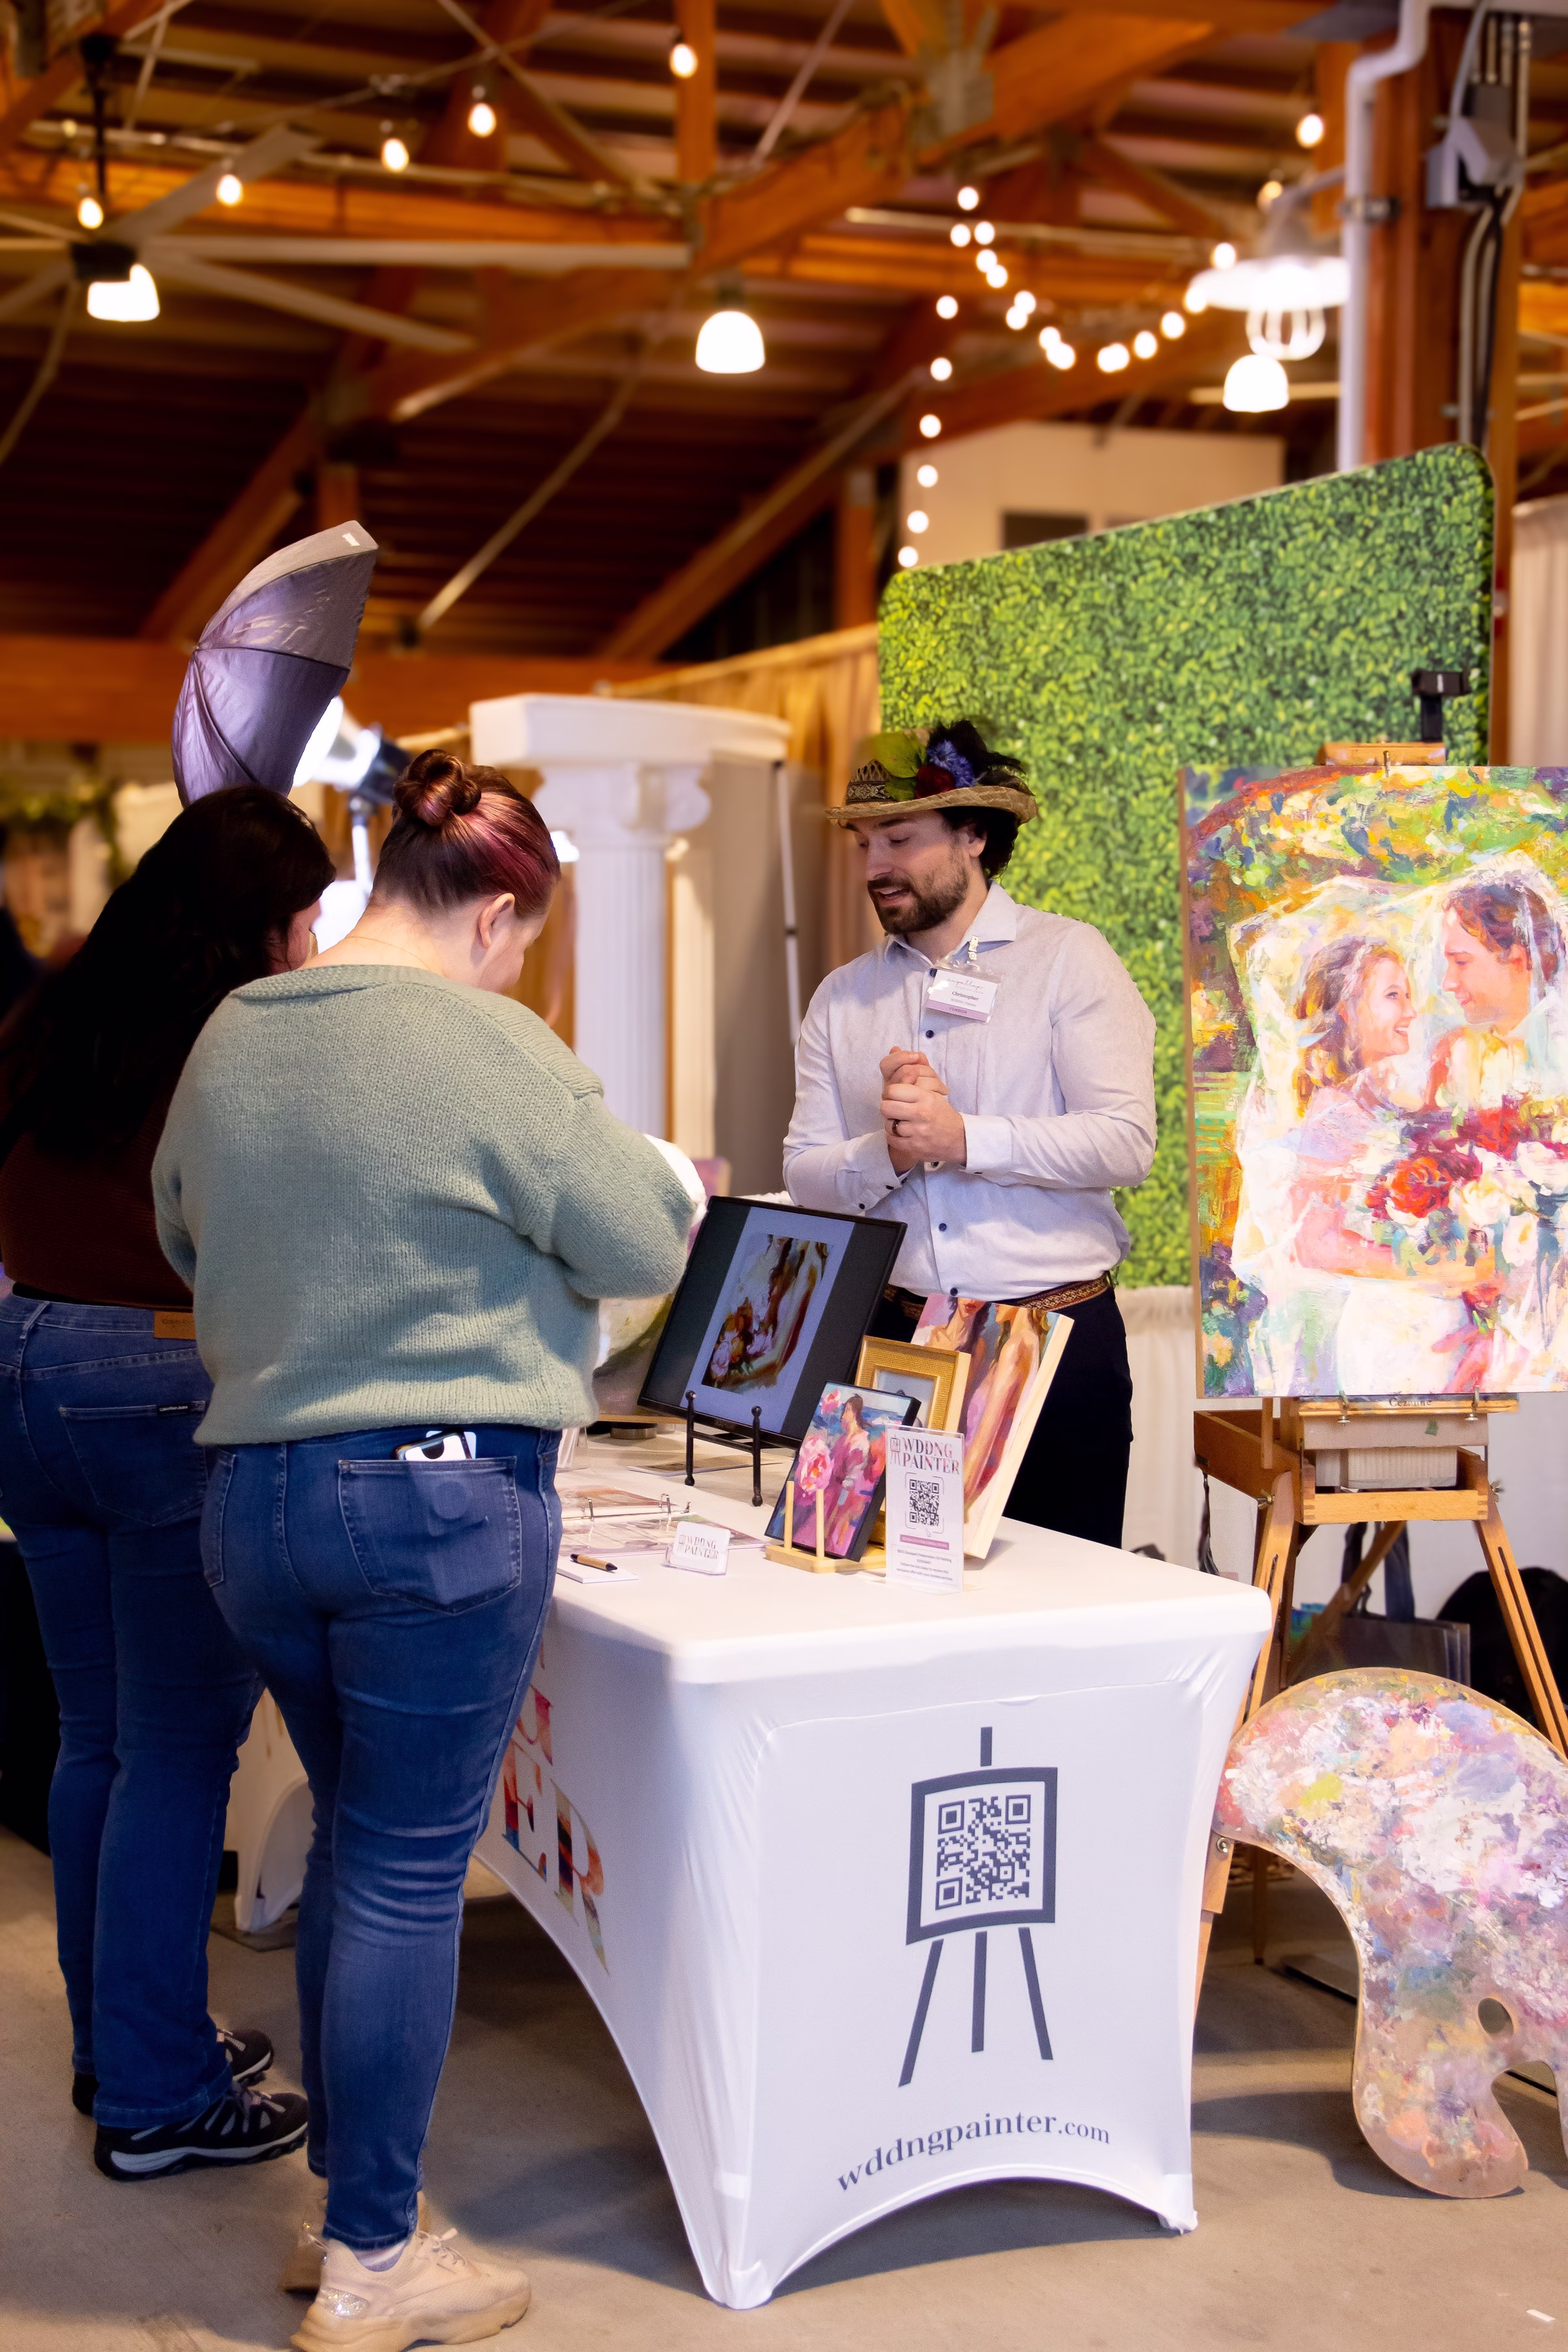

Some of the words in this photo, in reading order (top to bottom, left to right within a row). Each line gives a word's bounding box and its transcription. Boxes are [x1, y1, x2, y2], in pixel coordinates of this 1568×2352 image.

[952, 991, 979, 1001] Christopher
[902, 1437, 953, 1458] WDDNG
[903, 1452, 960, 1475] PAINTER
[687, 1535, 716, 1550] WDDNG
[685, 1544, 719, 1560] PAINTER
[837, 2111, 1110, 2191] wddngpainter.com
